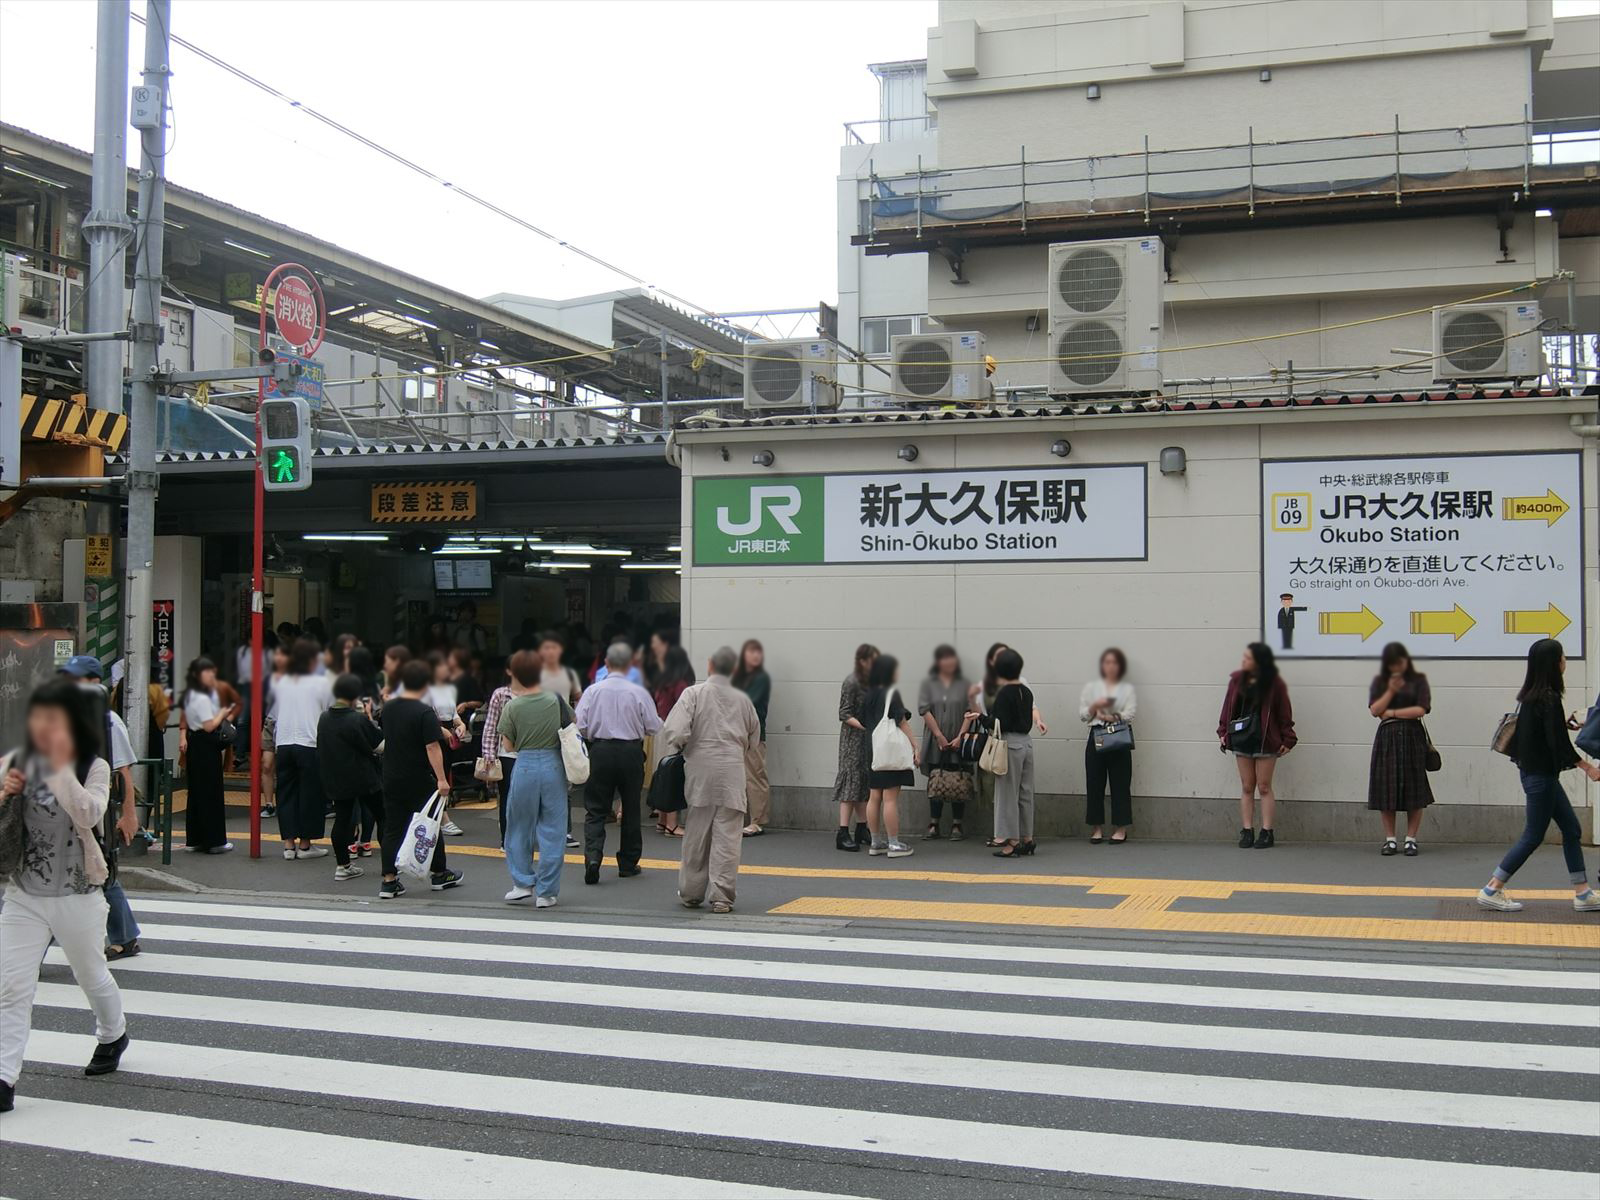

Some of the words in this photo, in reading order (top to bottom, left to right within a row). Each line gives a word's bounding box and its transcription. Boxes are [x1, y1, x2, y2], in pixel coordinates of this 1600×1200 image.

[279, 294, 313, 330] 消火栓
[1319, 472, 1449, 487] 中央・総武線各駅停車
[378, 491, 470, 513] 段差注意
[717, 485, 802, 536] JR
[860, 479, 1087, 527] 新大久保駅
[1284, 498, 1298, 509] JB
[1320, 491, 1493, 521] JR大久保駅
[1516, 503, 1563, 514] 約400m
[1280, 510, 1302, 525] 09
[860, 530, 979, 552] Shin-Ōkubo
[984, 532, 1058, 550] Station
[1320, 525, 1384, 543] Ōkubo
[1390, 526, 1459, 542] Station
[728, 539, 791, 554] JR東日本
[1289, 554, 1566, 575] 大久保通りを直進してください。
[1289, 578, 1307, 589] Go
[1310, 578, 1353, 591] straight
[1355, 580, 1370, 588] on
[1373, 576, 1440, 588] Ōkubo-dōri
[1443, 577, 1470, 588] Ave.
[56, 641, 70, 650] FREE
